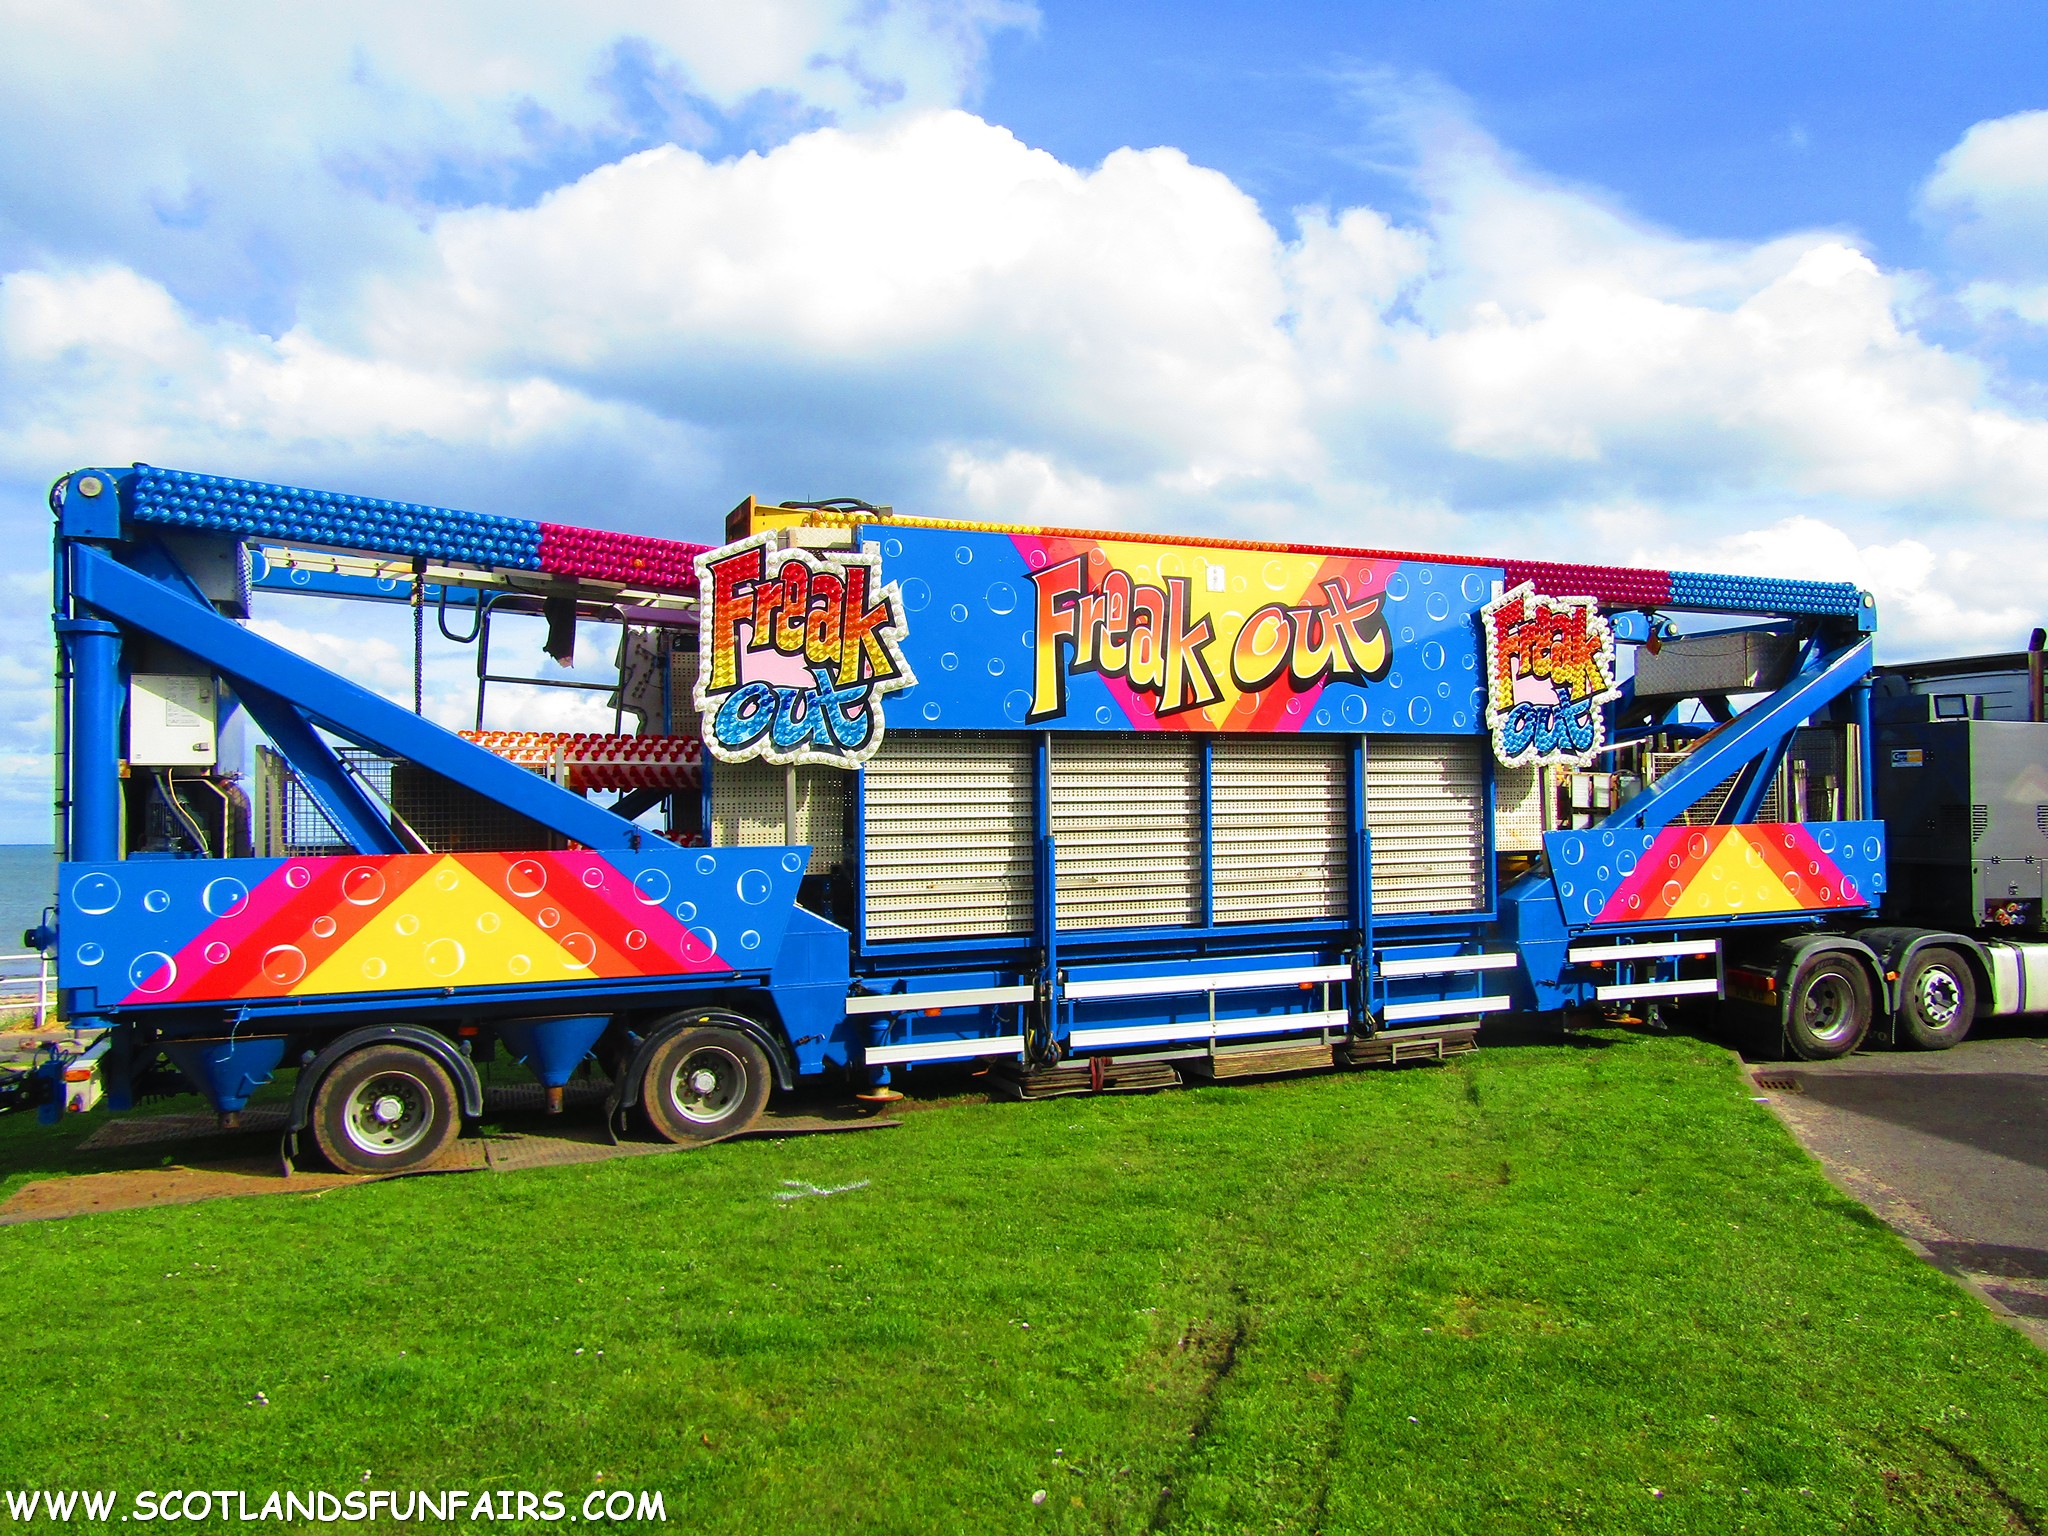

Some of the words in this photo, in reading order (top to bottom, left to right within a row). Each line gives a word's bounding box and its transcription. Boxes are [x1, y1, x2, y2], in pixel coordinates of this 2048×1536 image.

[706, 544, 904, 696] Freak
[1021, 553, 1225, 725] Freak
[1230, 578, 1393, 693] out
[1493, 594, 1608, 712] Freak
[714, 666, 876, 756] out
[1501, 687, 1596, 758] out
